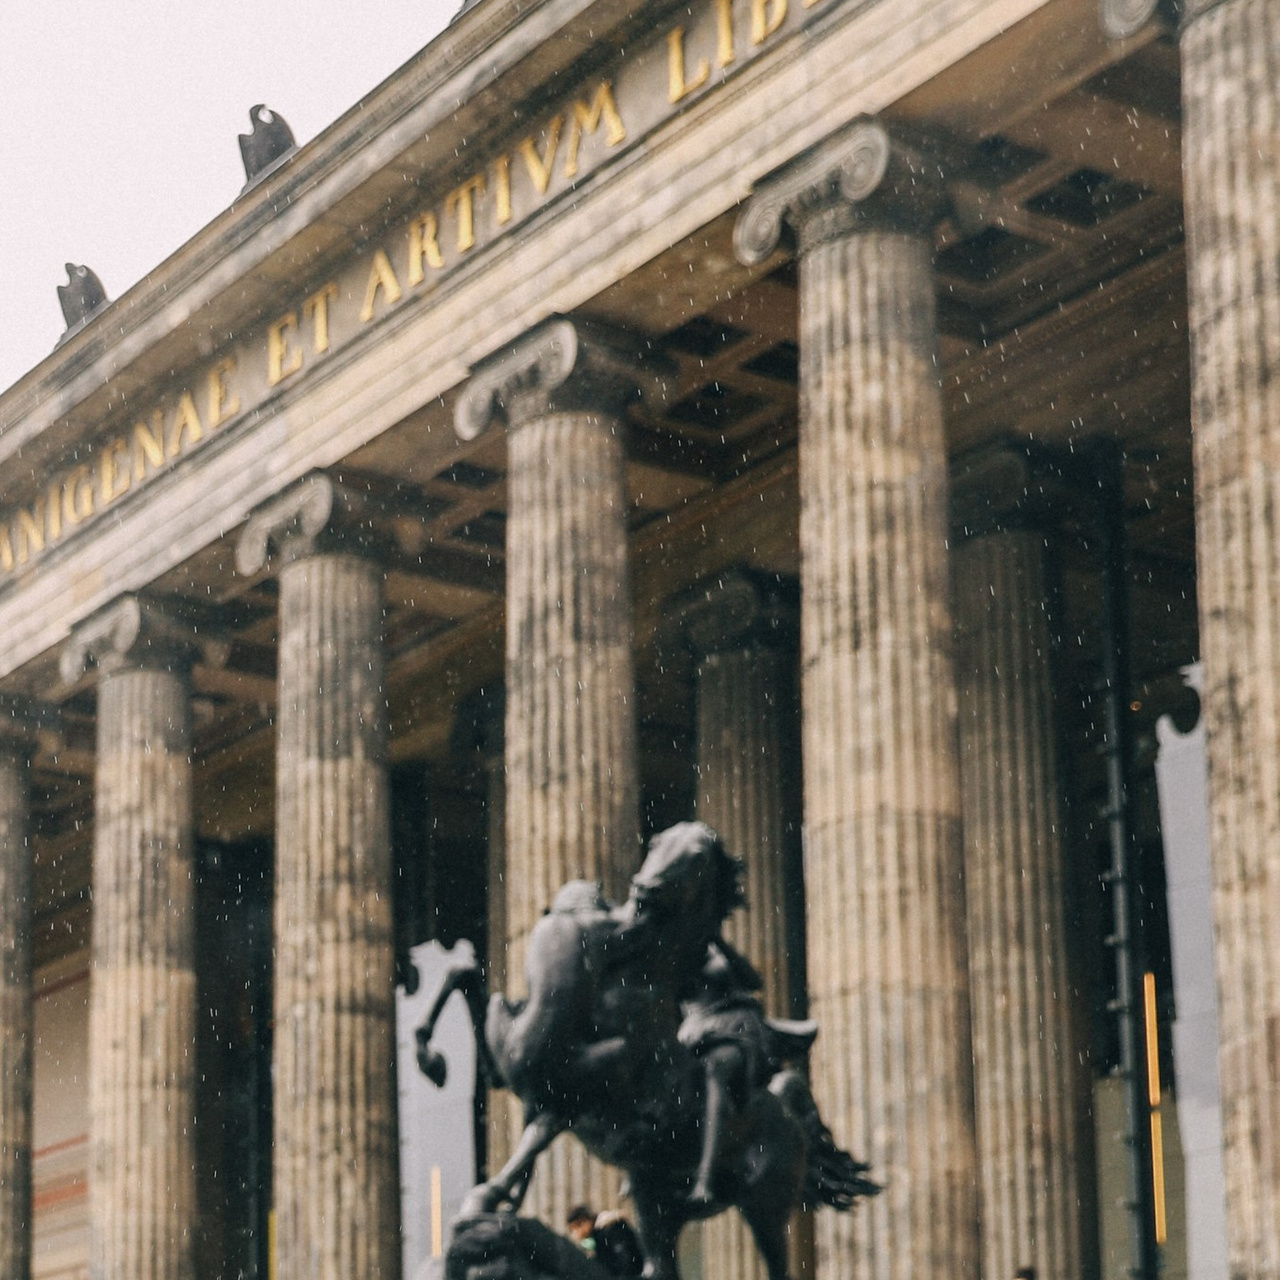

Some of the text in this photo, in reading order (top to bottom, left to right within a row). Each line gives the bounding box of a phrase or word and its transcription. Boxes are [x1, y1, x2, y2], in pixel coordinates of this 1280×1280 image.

[267, 283, 338, 388] ET
[360, 80, 626, 322] ARTIVM
[666, 0, 818, 104] LIB
